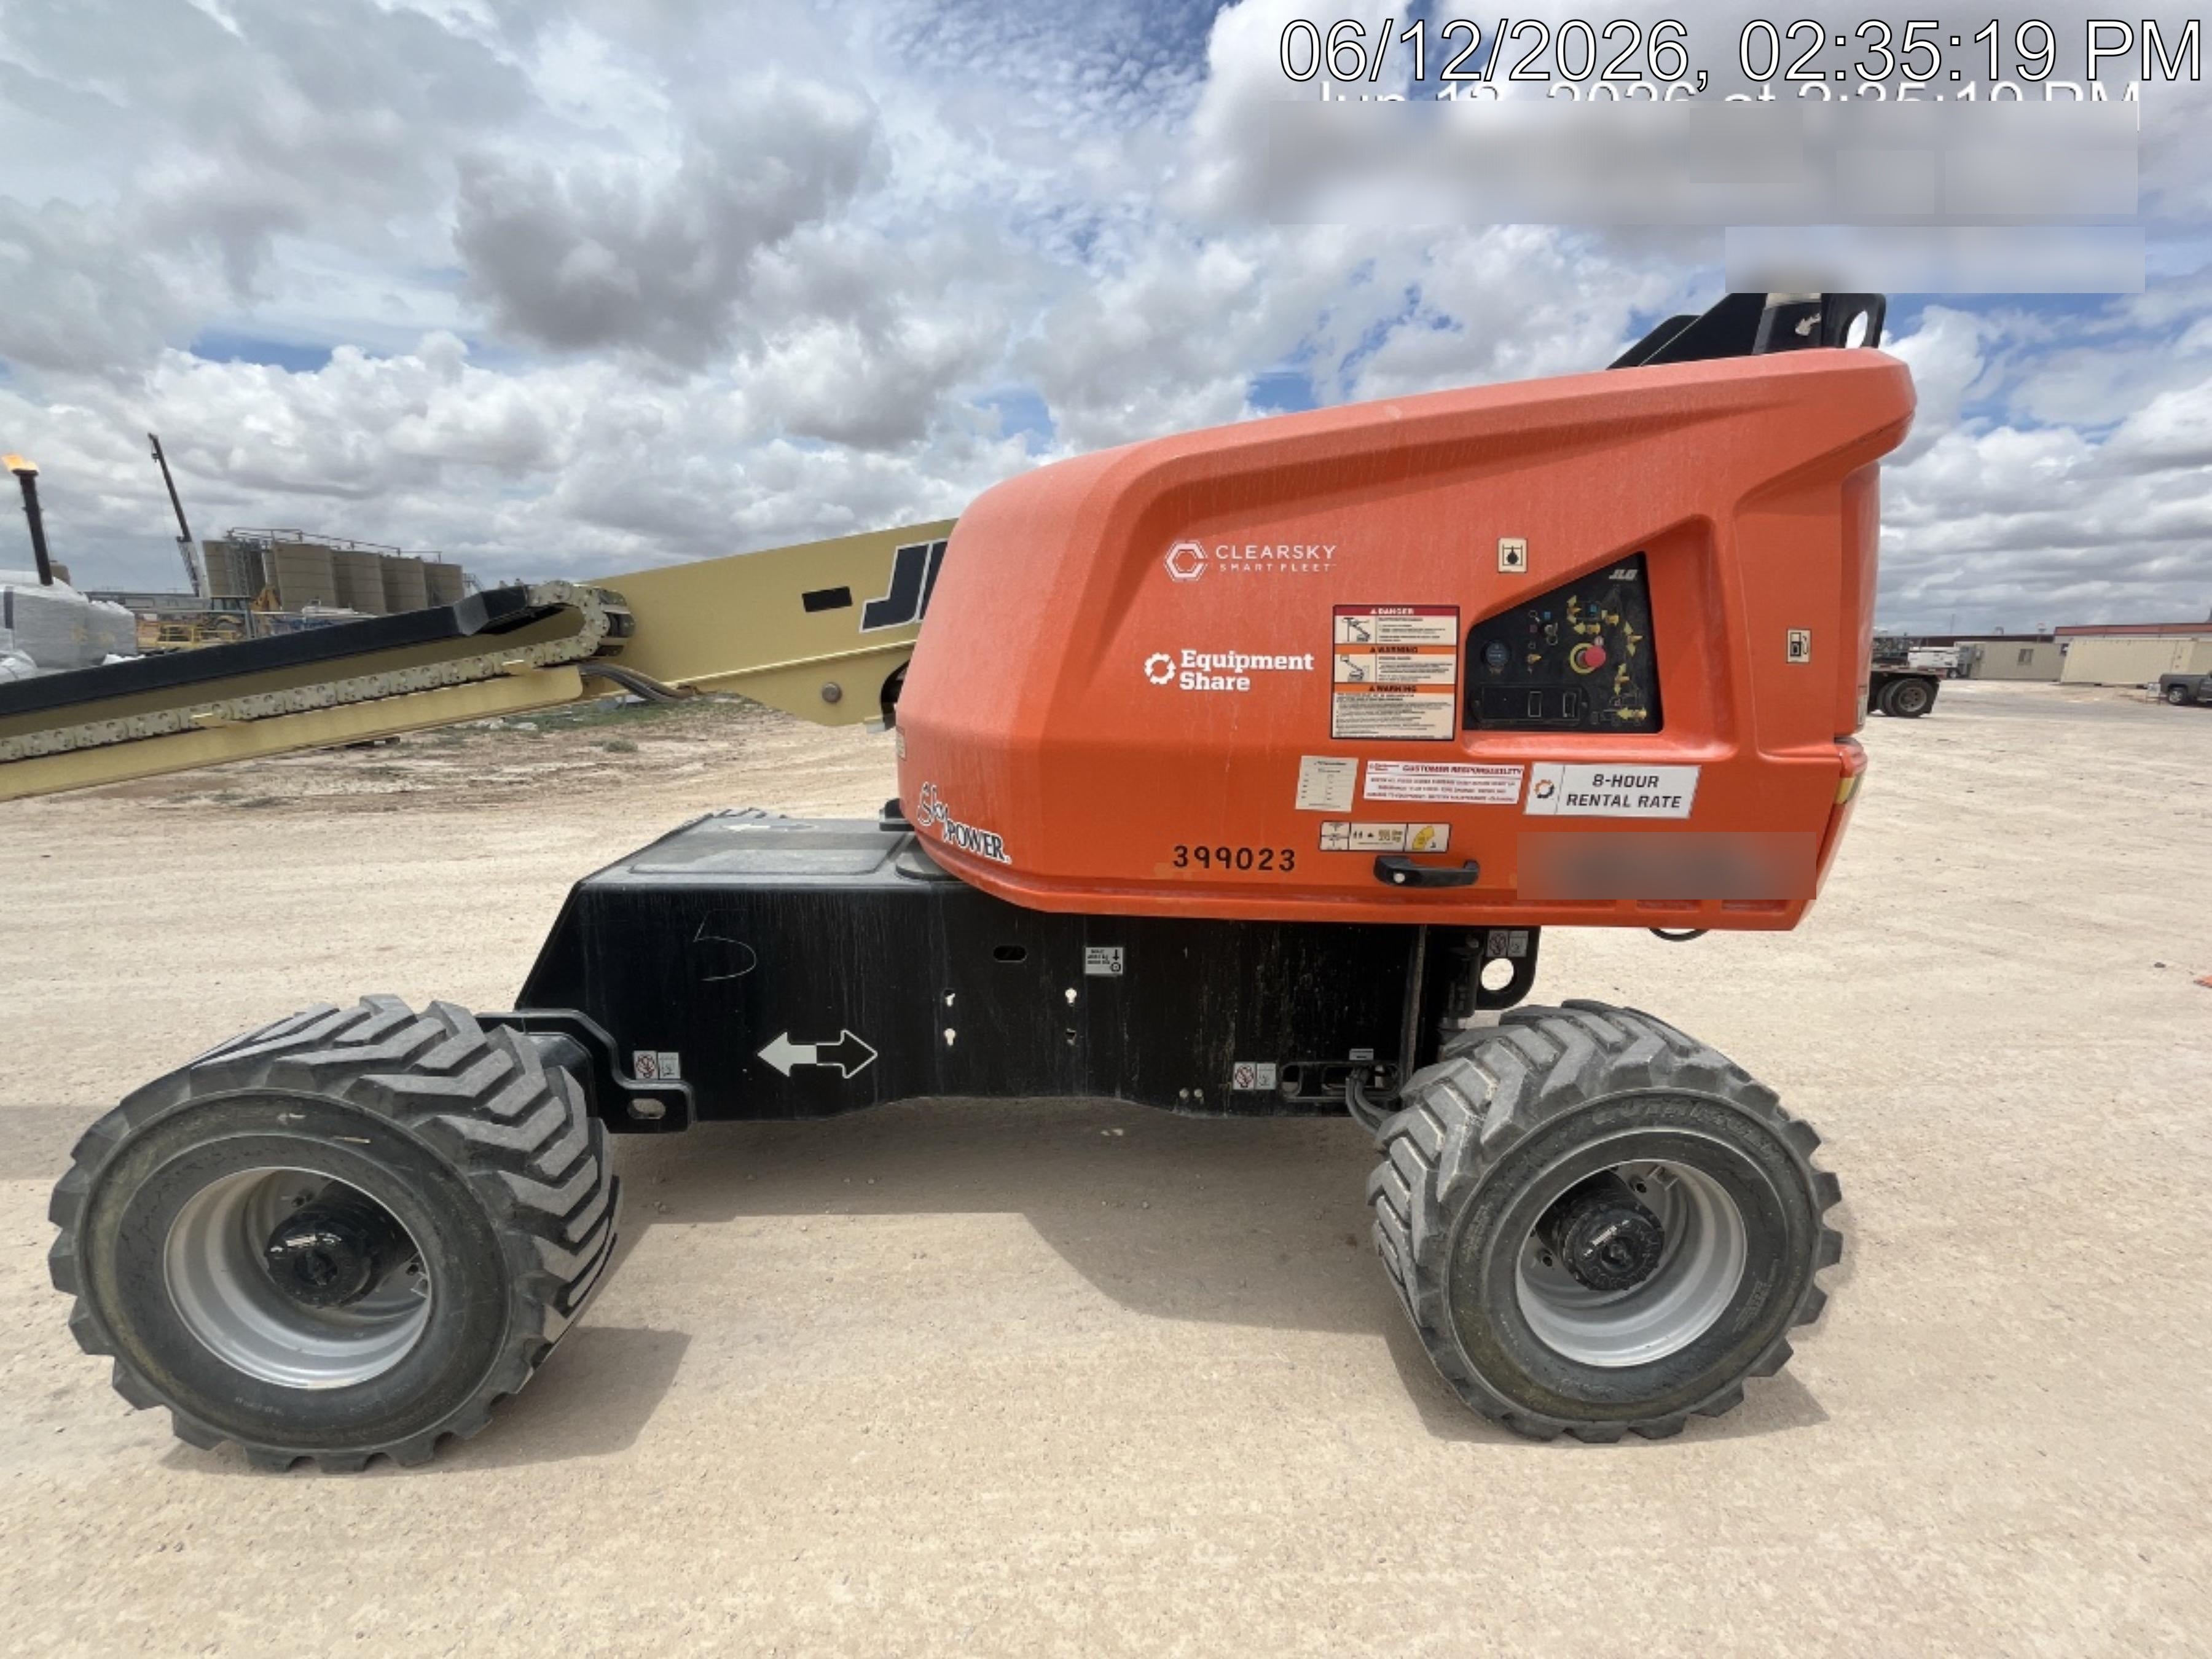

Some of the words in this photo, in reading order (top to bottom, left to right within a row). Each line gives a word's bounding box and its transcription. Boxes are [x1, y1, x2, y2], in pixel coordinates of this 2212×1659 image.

[1215, 545, 1336, 560] CLEARSKY
[1220, 563, 1274, 572] SMART
[1281, 563, 1331, 572] FLEET
[1181, 649, 1314, 673] Equipment
[1180, 671, 1250, 691] Share
[1592, 774, 1660, 788] 8-HOUR
[1566, 794, 1631, 807] RENTAL
[1637, 795, 1682, 808] RATE
[1173, 845, 1295, 871] 399023
